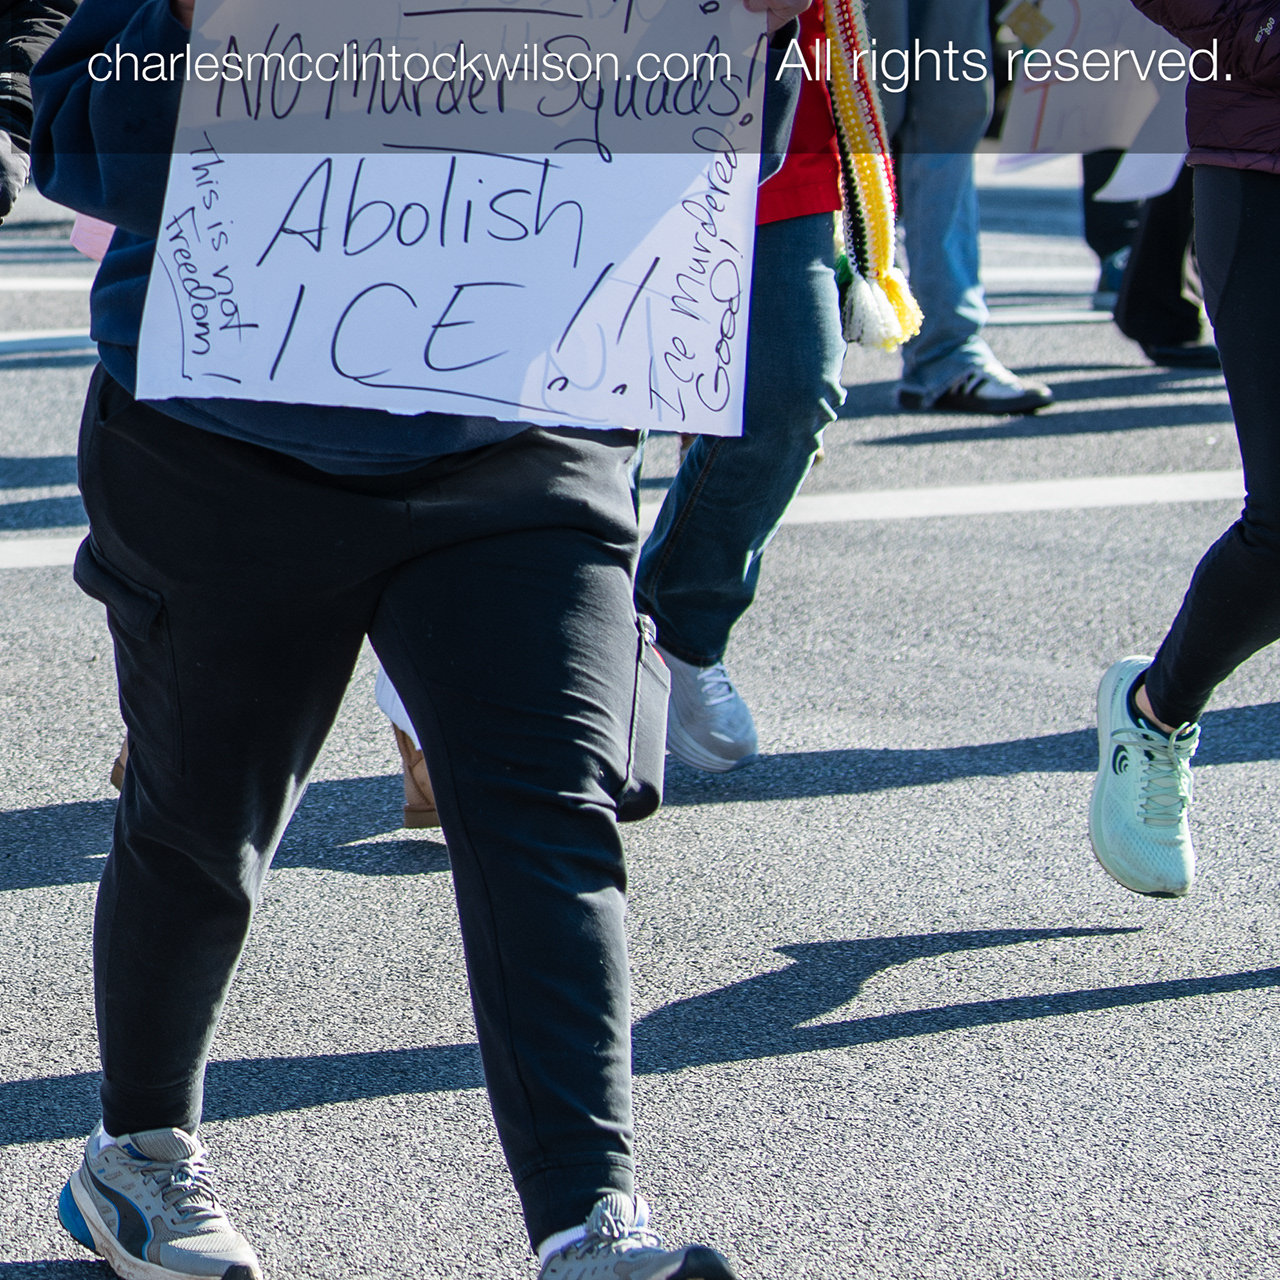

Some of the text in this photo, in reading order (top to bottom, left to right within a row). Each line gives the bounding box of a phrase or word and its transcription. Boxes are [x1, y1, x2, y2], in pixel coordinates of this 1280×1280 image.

[326, 38, 514, 122] Murder
[190, 131, 260, 344] This is not
[256, 156, 585, 268] Abolish
